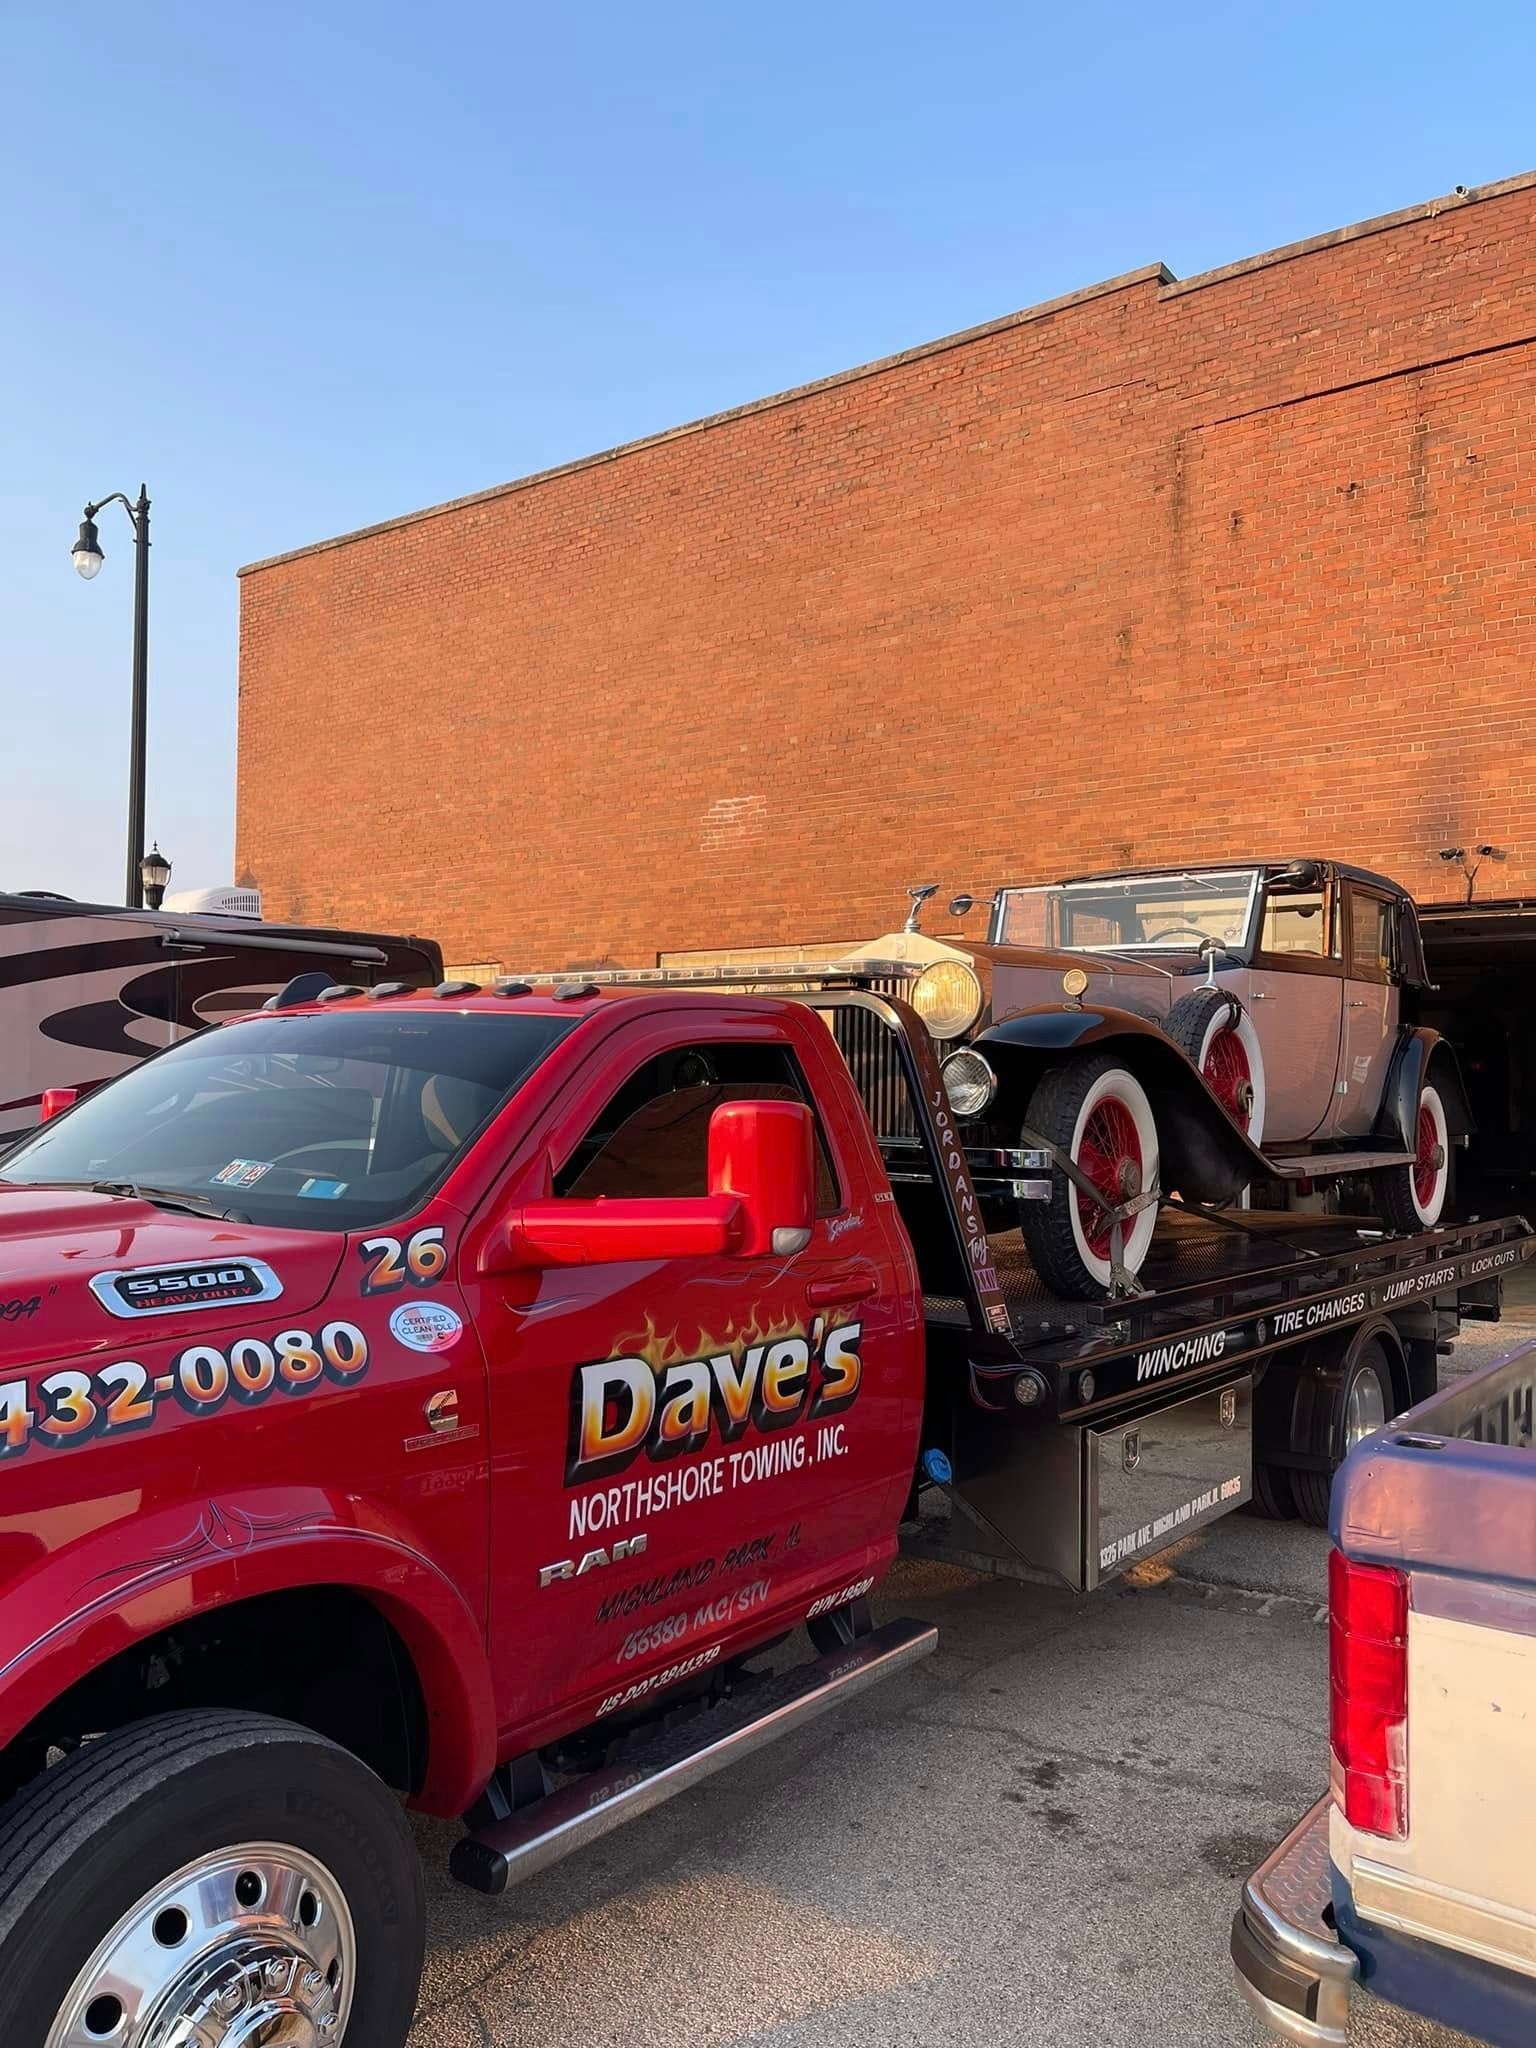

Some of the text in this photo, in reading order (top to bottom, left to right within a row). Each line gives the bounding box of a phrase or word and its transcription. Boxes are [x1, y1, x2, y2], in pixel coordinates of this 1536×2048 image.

[128, 1269, 245, 1295] 5500
[360, 1228, 448, 1292] 26
[135, 1285, 252, 1309] HEAVY DUTY
[402, 1314, 447, 1326] CERTIFIED
[1136, 1249, 1515, 1383] WINCHING TIRE CHANGES JUMP STARTS LOCK OUTS
[401, 1321, 453, 1335] CLEAN IDLE
[573, 1317, 861, 1470] Dave's
[569, 1457, 725, 1540] NORTHSHORE
[816, 1423, 849, 1461] INC.
[1117, 1531, 1137, 1560] PARK
[1153, 1503, 1191, 1538] HIGHLAND
[539, 1533, 648, 1588] RAM
[595, 1557, 716, 1624] HIGHLAND
[595, 1692, 623, 1717] US
[620, 1674, 658, 1706] DOT
